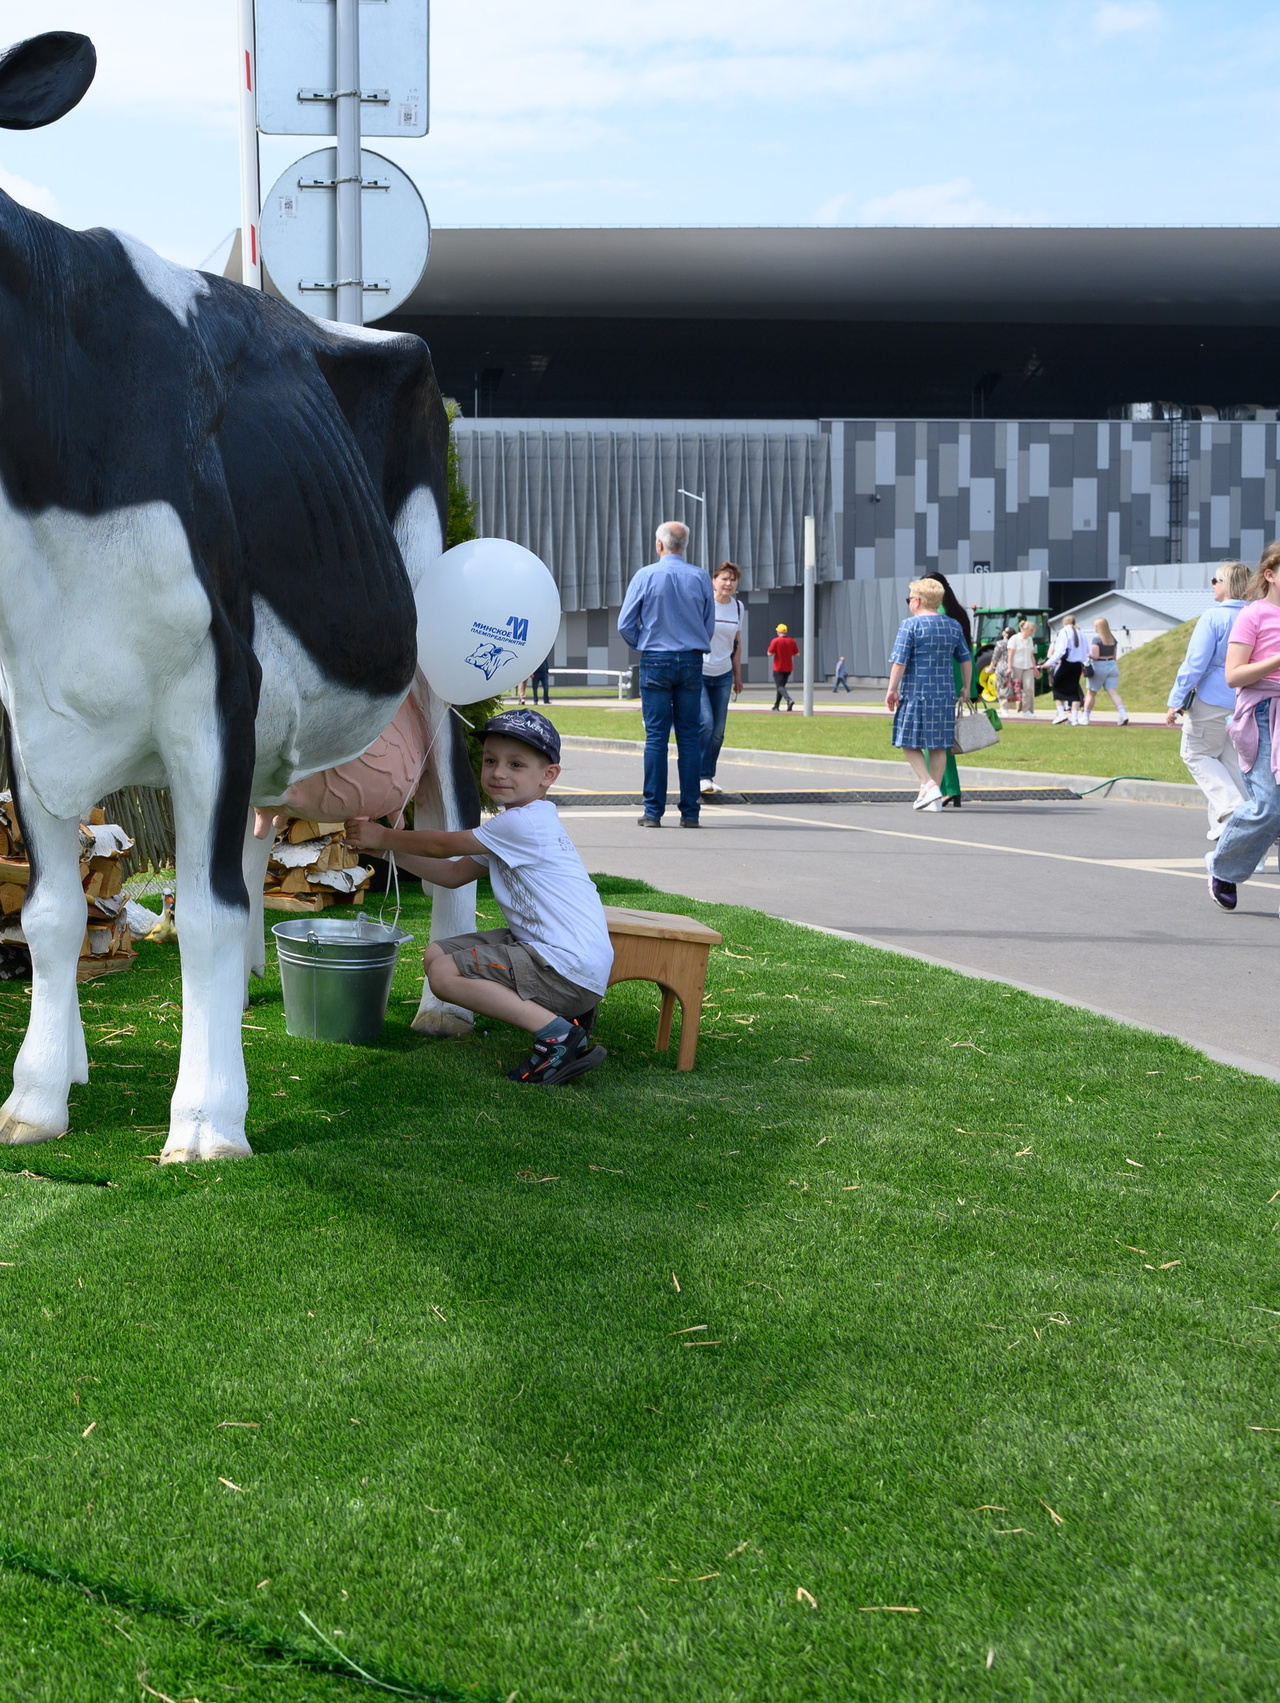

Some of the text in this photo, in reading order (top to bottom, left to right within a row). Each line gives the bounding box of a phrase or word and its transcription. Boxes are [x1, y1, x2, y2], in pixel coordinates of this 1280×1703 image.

[974, 565, 990, 575] G5
[472, 621, 512, 637] МИНСКОЕ
[470, 628, 526, 646] ПЛЕМПРЕДПРИЯТИЕ
[526, 721, 543, 734] AREA
